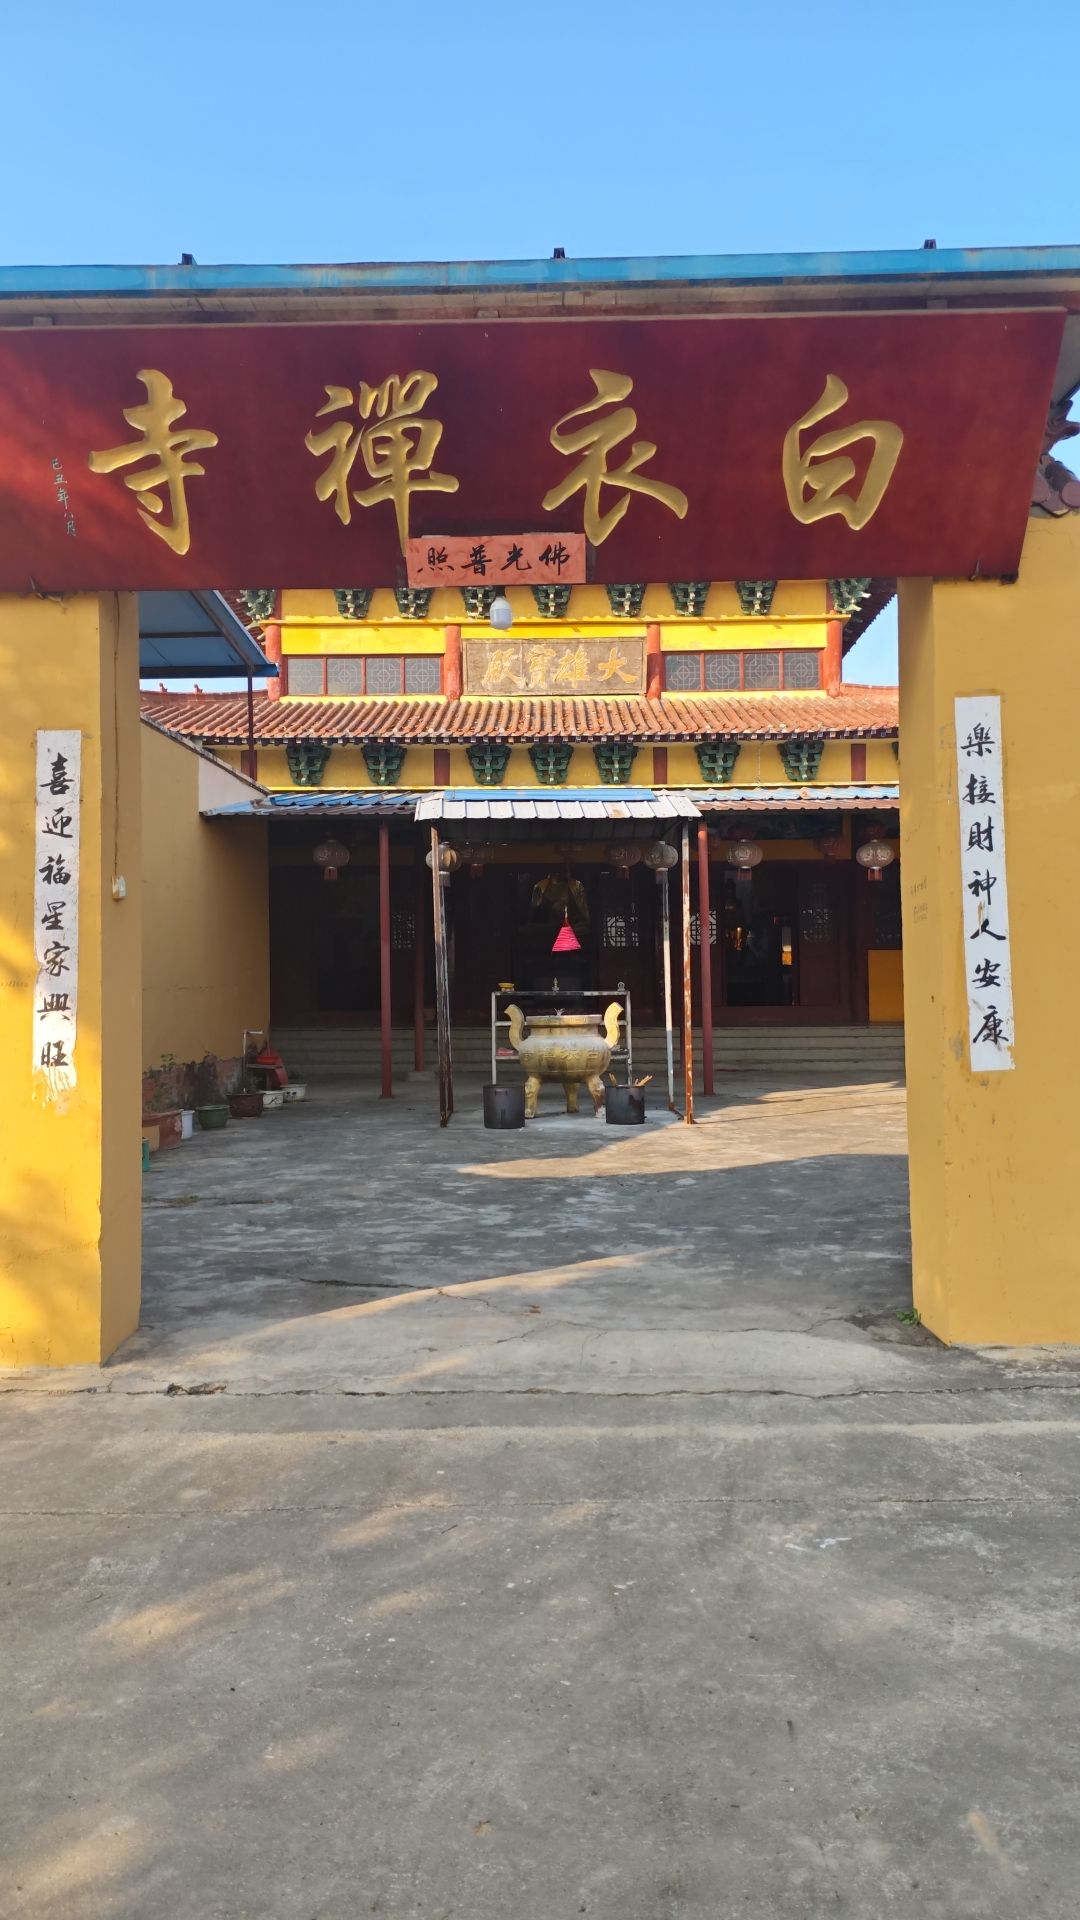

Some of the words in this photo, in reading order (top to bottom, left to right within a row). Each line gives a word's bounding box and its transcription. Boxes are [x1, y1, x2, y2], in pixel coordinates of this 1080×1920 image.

[88, 368, 904, 556] 白衣禪寺
[417, 541, 571, 576] 佛光普照
[38, 752, 74, 1068] 喜迎福星家興旺
[960, 722, 1010, 1044] 樂接財神人安康
